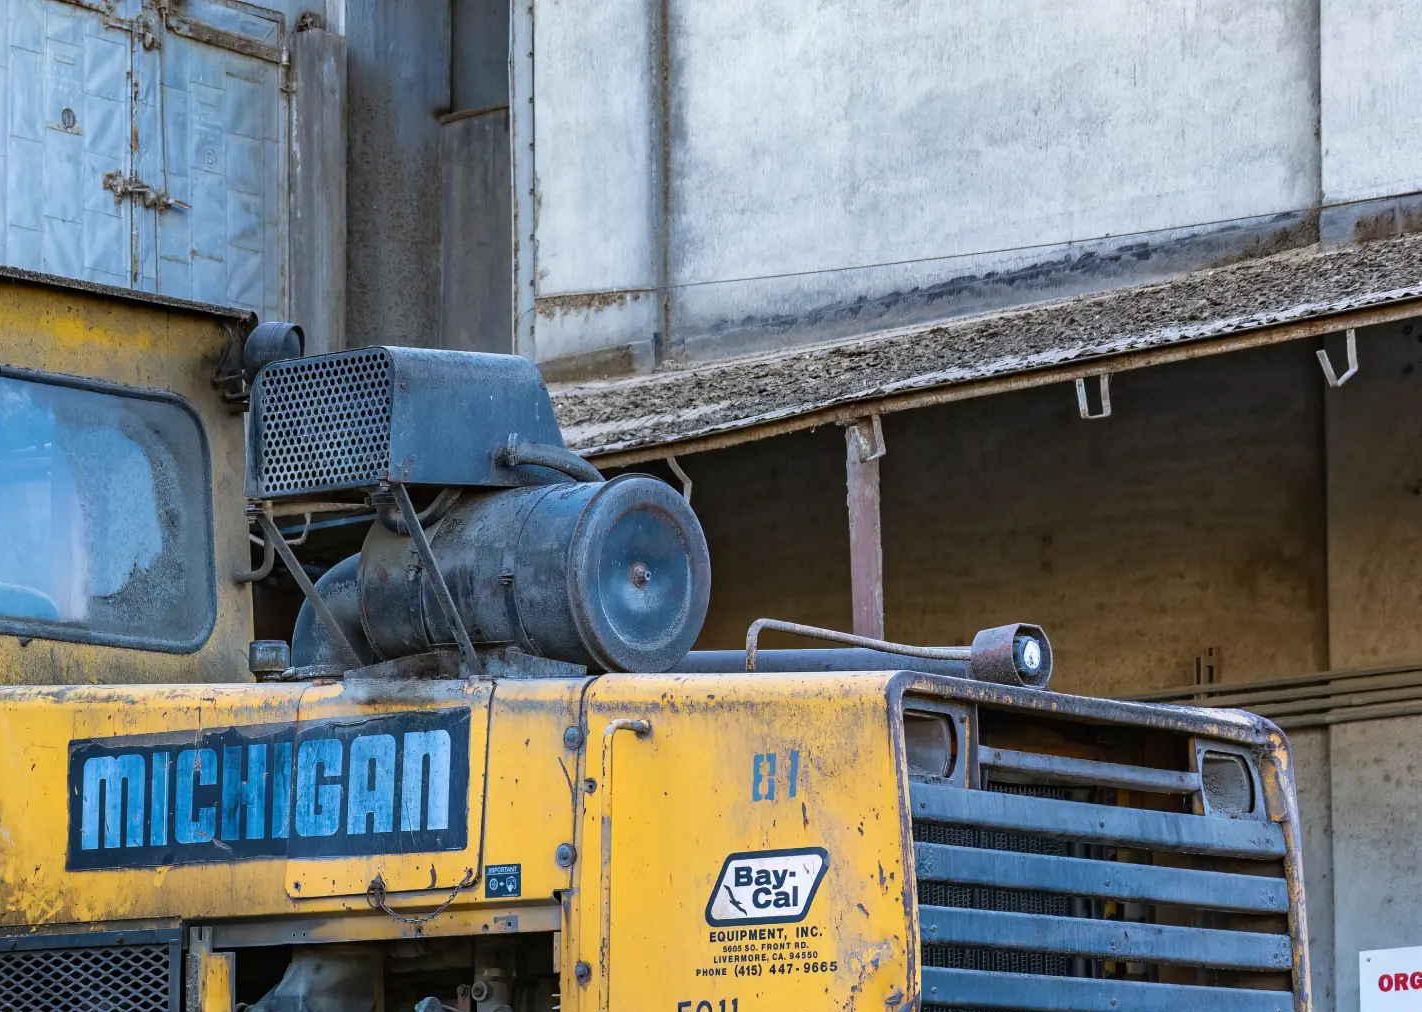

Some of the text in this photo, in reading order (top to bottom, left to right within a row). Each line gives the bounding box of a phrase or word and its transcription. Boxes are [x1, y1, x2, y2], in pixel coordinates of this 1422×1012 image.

[81, 729, 451, 851] MICHIGAN
[734, 866, 796, 890] Bay-
[752, 886, 798, 909] Cal
[709, 925, 823, 942] EQUIPMENT, INC.
[744, 943, 758, 951] SO.
[761, 942, 791, 951] FRONT
[794, 941, 809, 949] RD.
[713, 951, 818, 964] LIVERMORE, CA. 94550
[696, 968, 727, 976] PHONE
[734, 964, 762, 977] (415)
